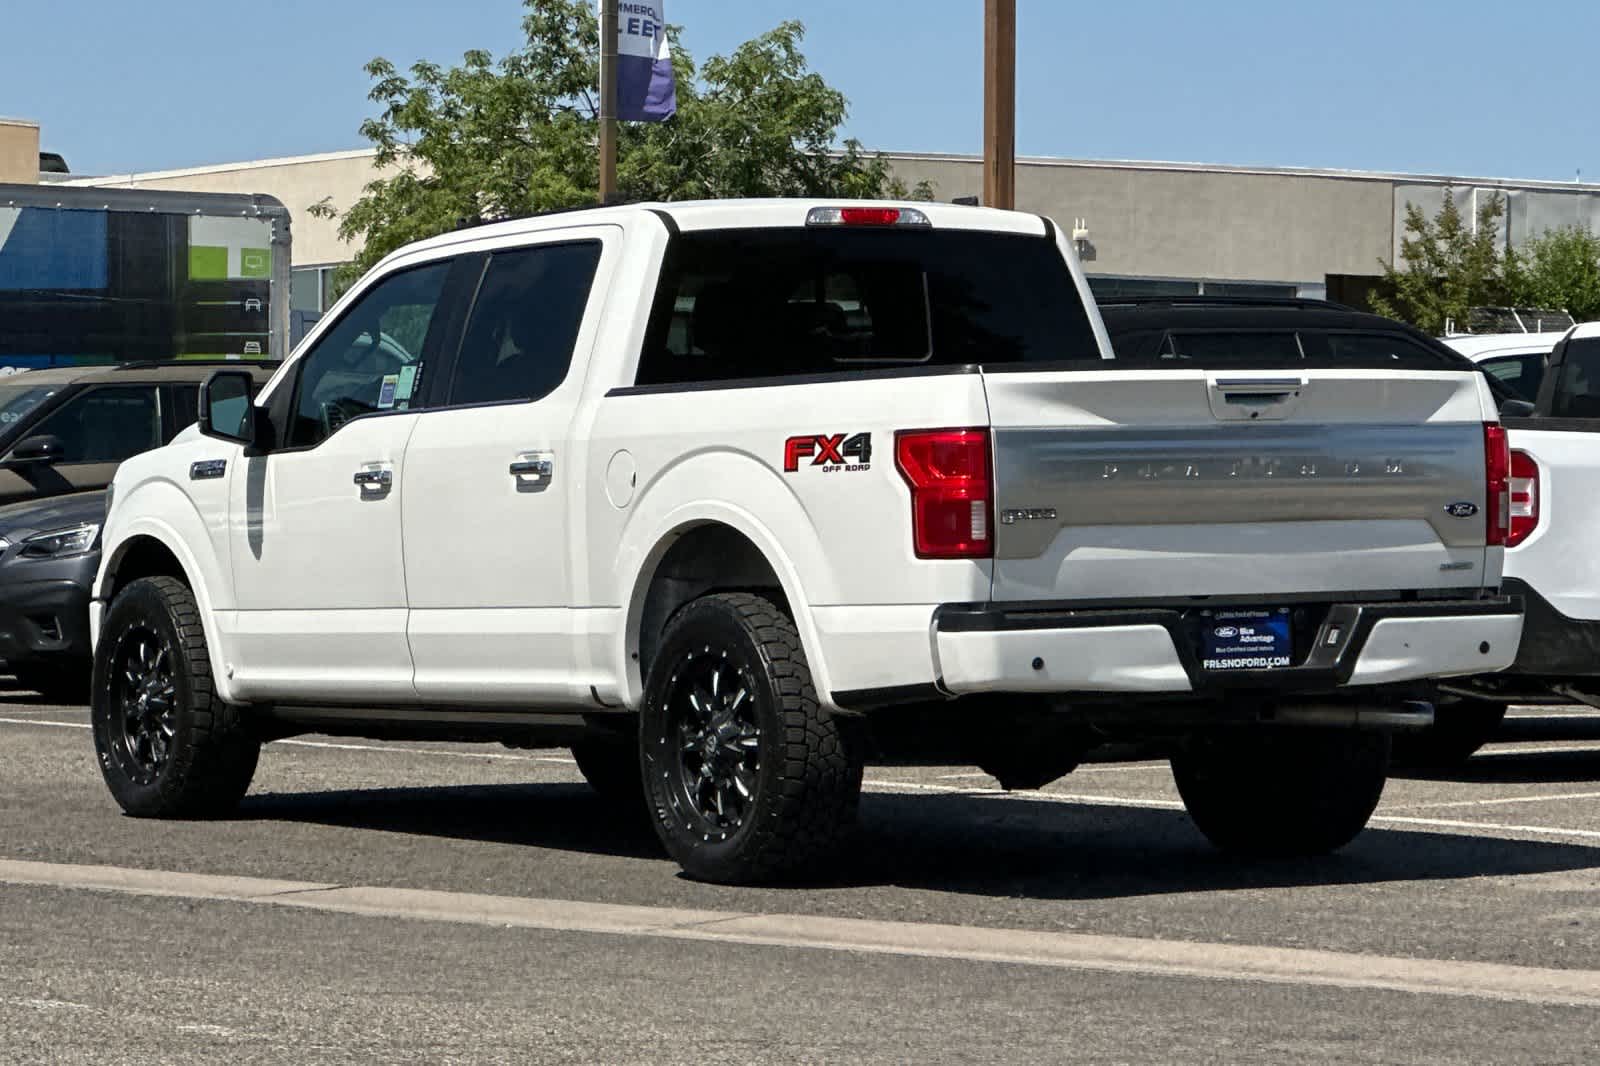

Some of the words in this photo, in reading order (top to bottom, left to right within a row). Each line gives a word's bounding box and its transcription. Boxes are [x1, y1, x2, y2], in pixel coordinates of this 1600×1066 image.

[784, 432, 872, 472] FX4
[845, 464, 871, 472] ROAD
[1203, 657, 1290, 669] FRESNOFORD.COM
